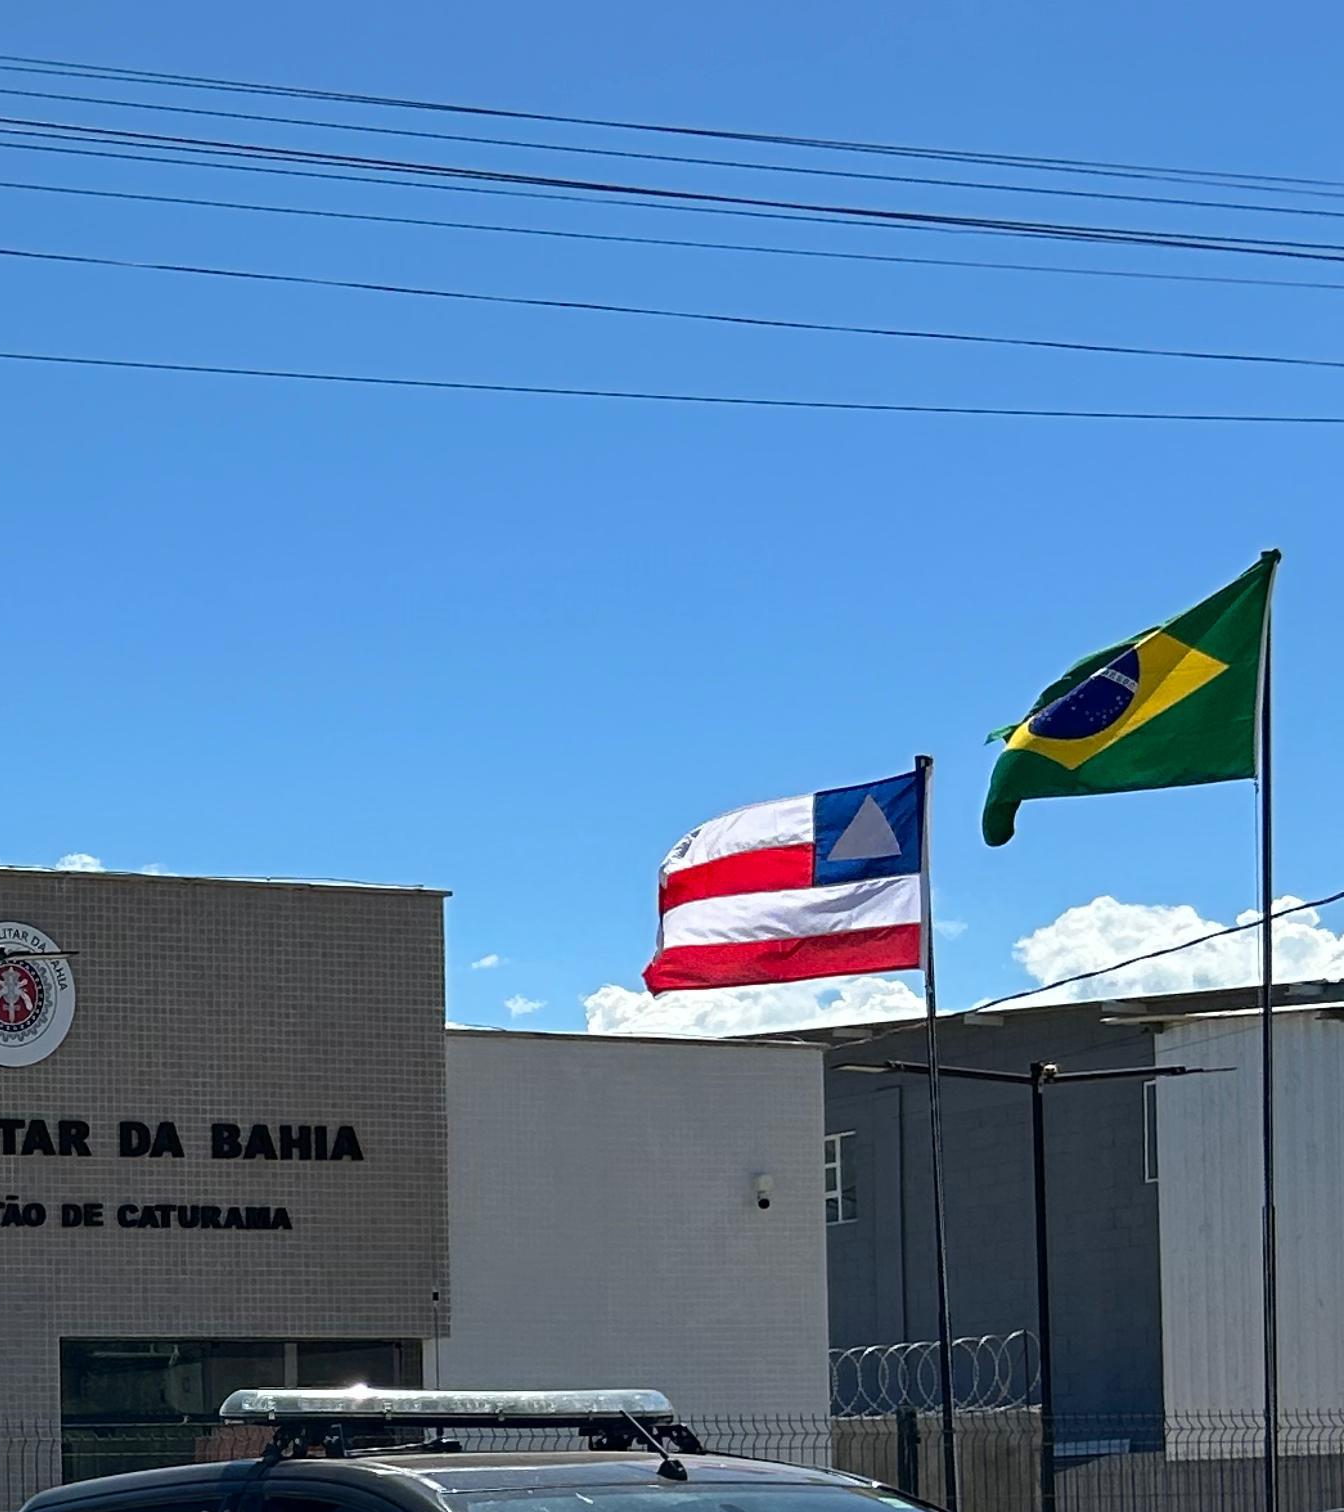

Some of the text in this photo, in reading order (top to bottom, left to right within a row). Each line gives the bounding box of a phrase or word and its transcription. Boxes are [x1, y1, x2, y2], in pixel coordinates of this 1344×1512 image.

[31, 935, 46, 953] DA
[119, 1120, 184, 1159] DA
[213, 1122, 364, 1162] BAHIA
[62, 1203, 104, 1228] DE
[116, 1203, 293, 1230] CATURAMA
